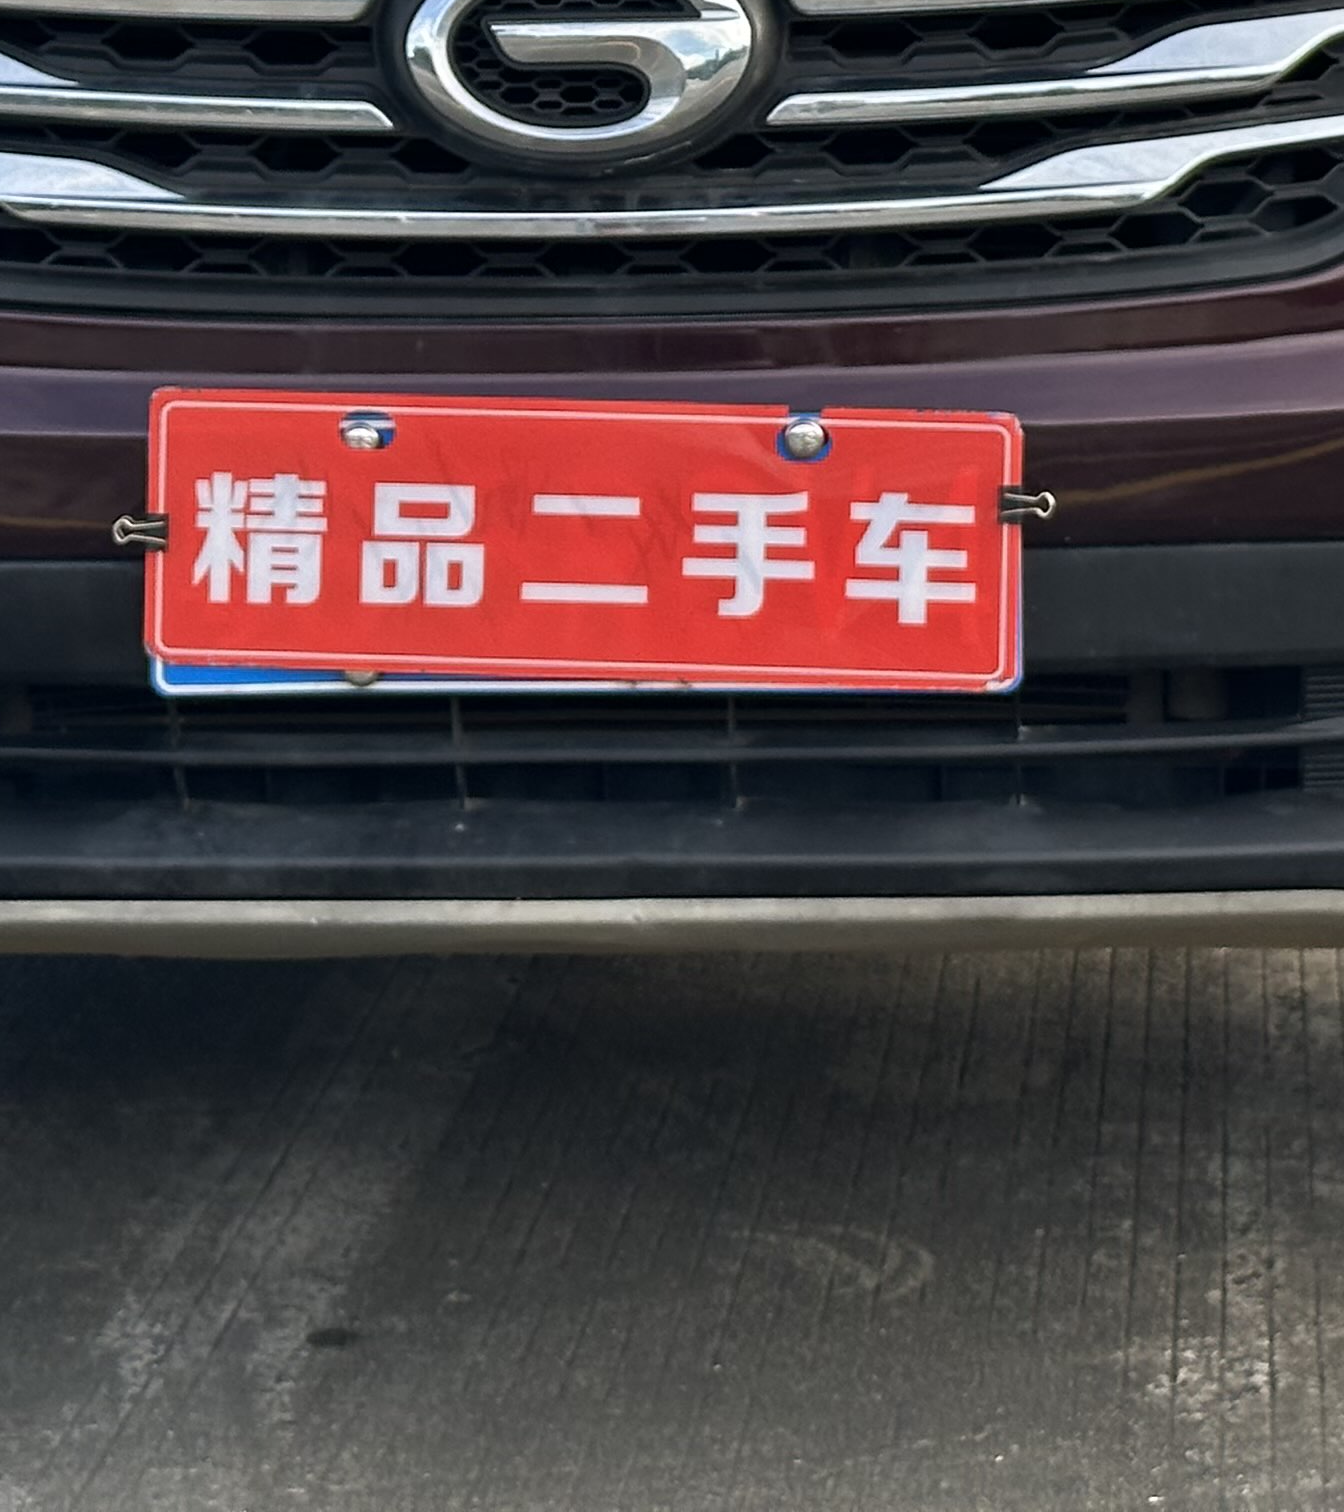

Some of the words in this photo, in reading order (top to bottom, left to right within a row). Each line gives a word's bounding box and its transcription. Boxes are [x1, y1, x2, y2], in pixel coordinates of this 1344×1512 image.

[191, 470, 978, 626] 精品二手车
